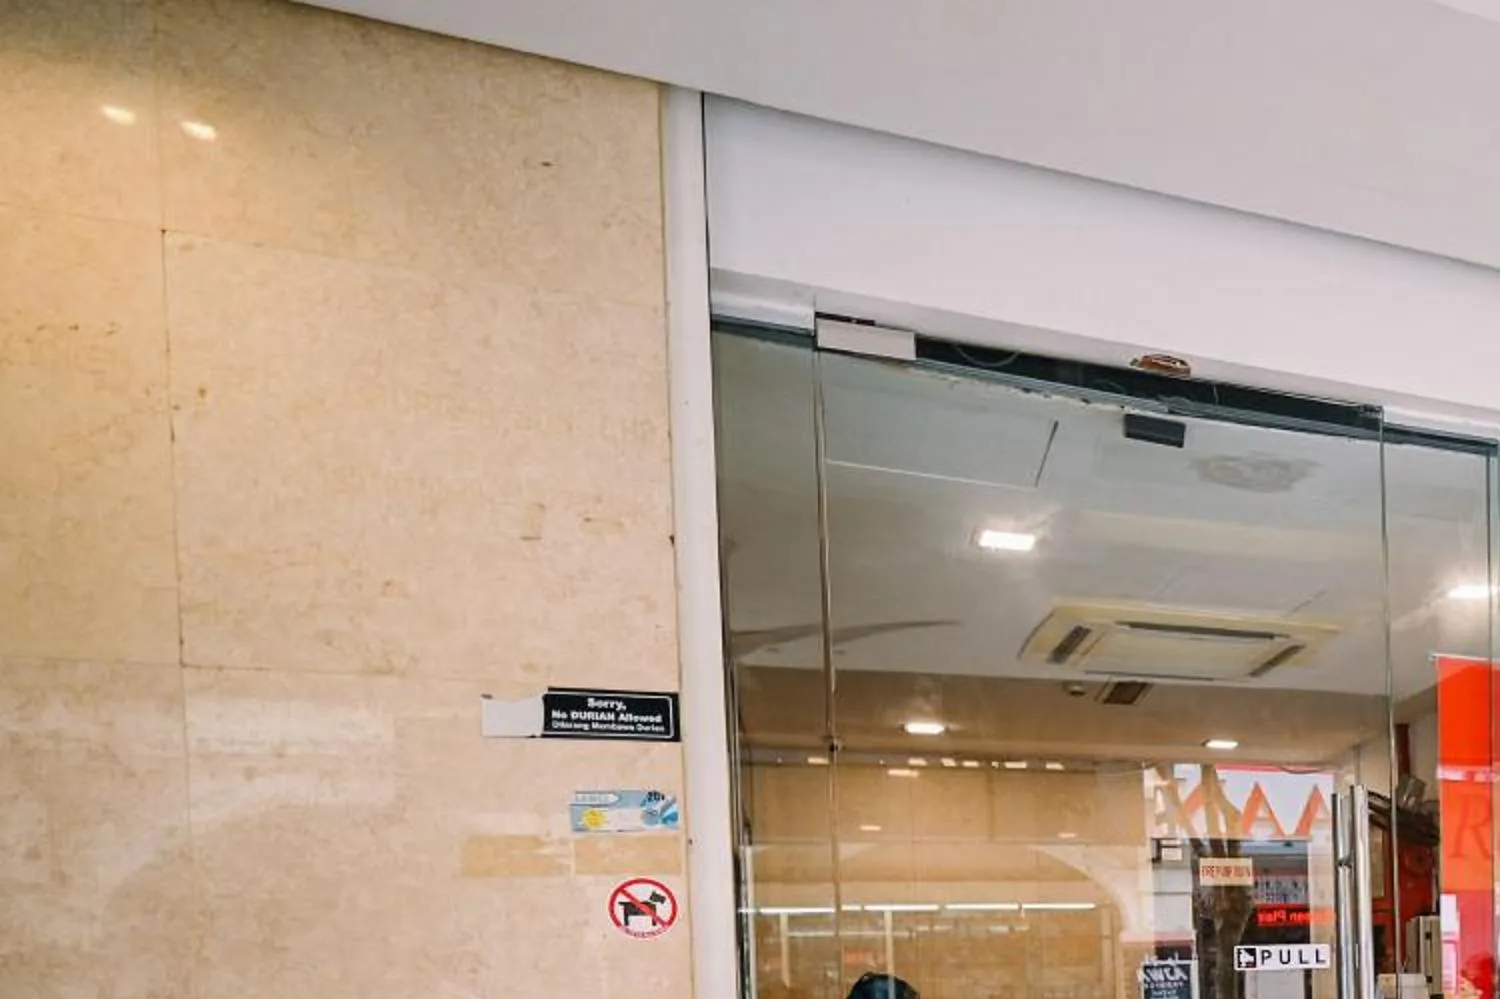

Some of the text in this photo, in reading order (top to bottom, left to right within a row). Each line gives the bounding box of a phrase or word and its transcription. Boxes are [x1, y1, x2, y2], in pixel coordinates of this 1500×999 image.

[587, 697, 627, 711] Sorry,
[551, 709, 662, 723] No DURIAN Allowed
[1261, 949, 1327, 966] PULL
